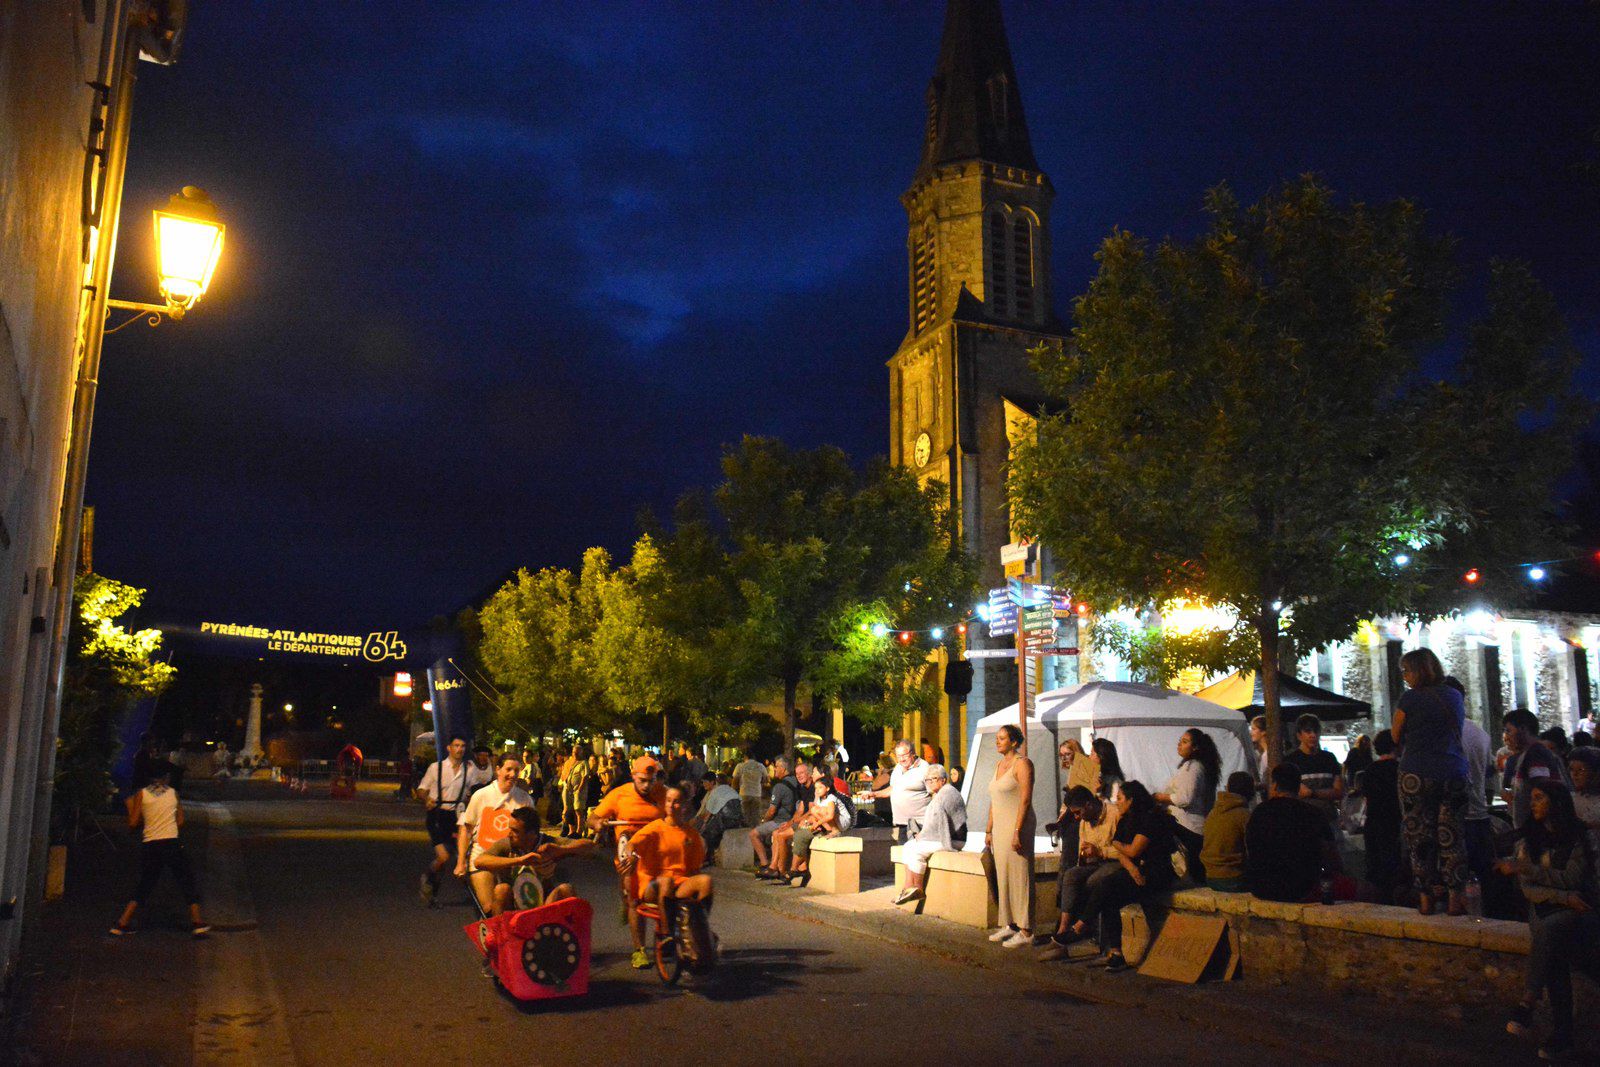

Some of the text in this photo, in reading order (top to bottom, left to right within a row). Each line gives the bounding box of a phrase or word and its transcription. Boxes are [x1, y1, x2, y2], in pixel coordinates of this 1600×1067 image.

[201, 622, 362, 647] PYRÉNÉES-ATLANTIQUES
[363, 631, 407, 662] 64
[268, 640, 361, 656] LE DÉPARTEMENT
